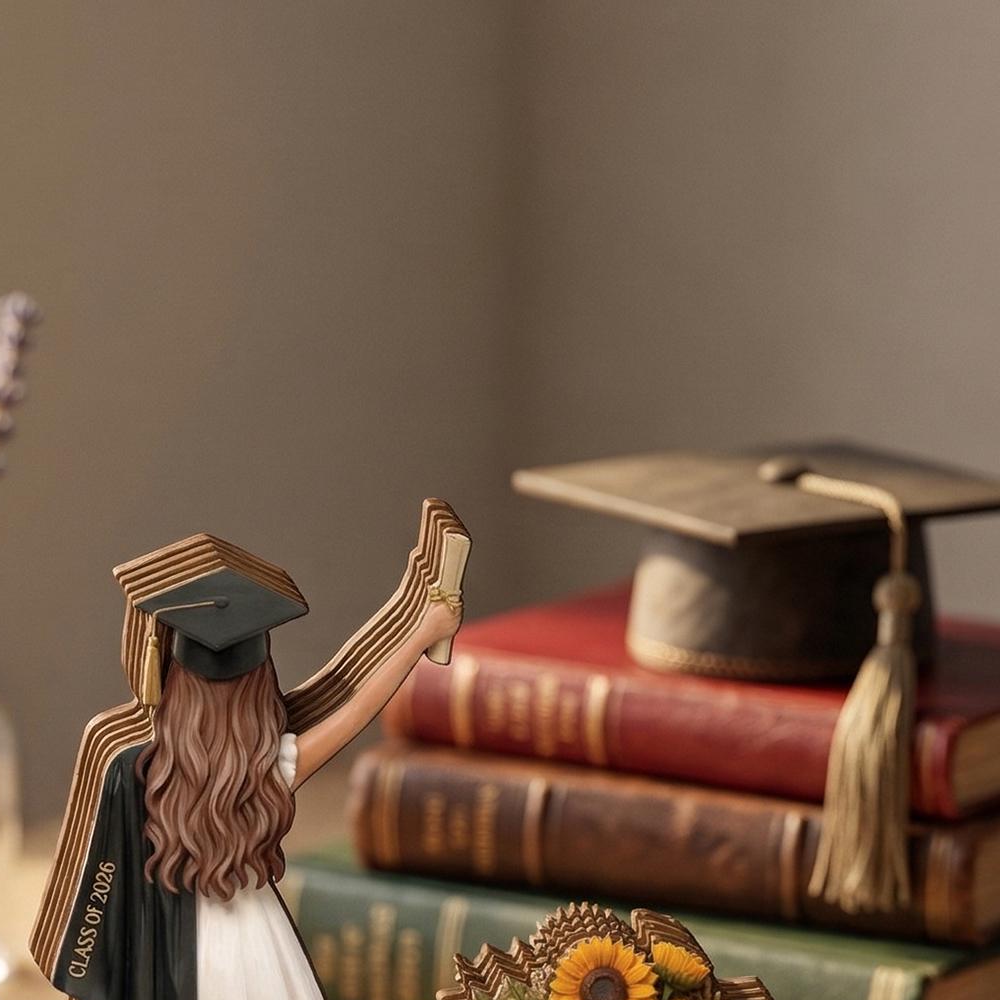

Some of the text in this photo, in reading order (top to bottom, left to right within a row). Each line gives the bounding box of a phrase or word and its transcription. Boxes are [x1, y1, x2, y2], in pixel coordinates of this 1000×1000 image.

[68, 861, 116, 979] CLASS OF 2026
